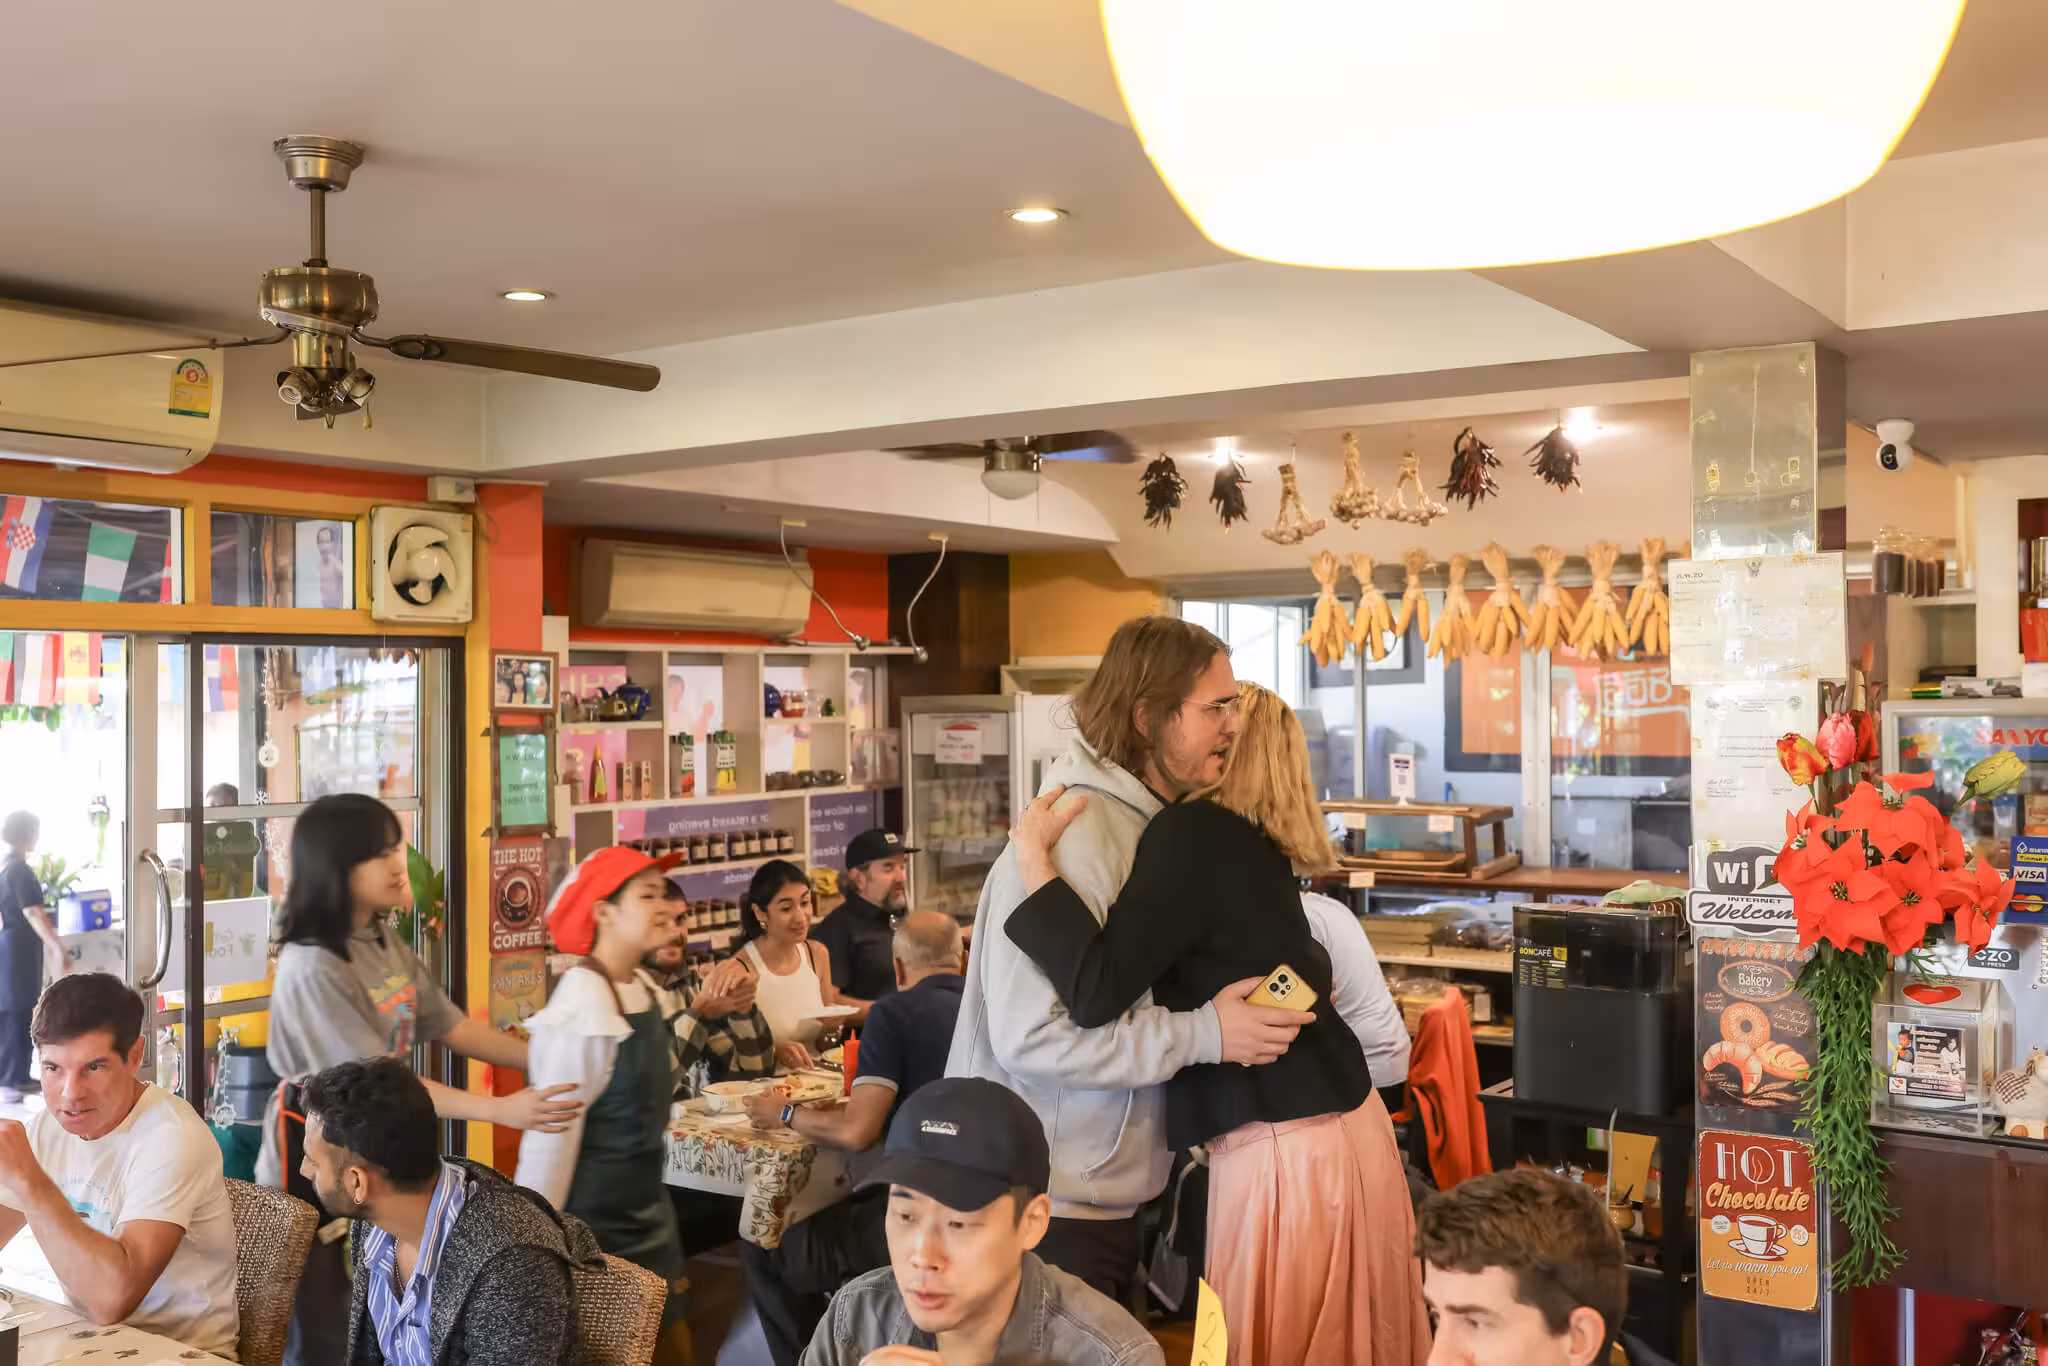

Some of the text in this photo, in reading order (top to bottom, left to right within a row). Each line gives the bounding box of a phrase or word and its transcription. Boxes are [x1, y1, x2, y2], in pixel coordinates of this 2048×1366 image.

[494, 847, 542, 865] THE HOT
[2015, 870, 2046, 880] VISA
[1727, 896, 1782, 905] INTERNET
[1698, 901, 1795, 920] Welcom
[493, 931, 543, 949] COFFEE
[1738, 973, 1773, 988] Bakery
[1715, 1142, 1799, 1188] HOT
[1705, 1181, 1810, 1212] Chocolate
[1706, 1257, 1721, 1269] Let
[1735, 1262, 1769, 1273] warm
